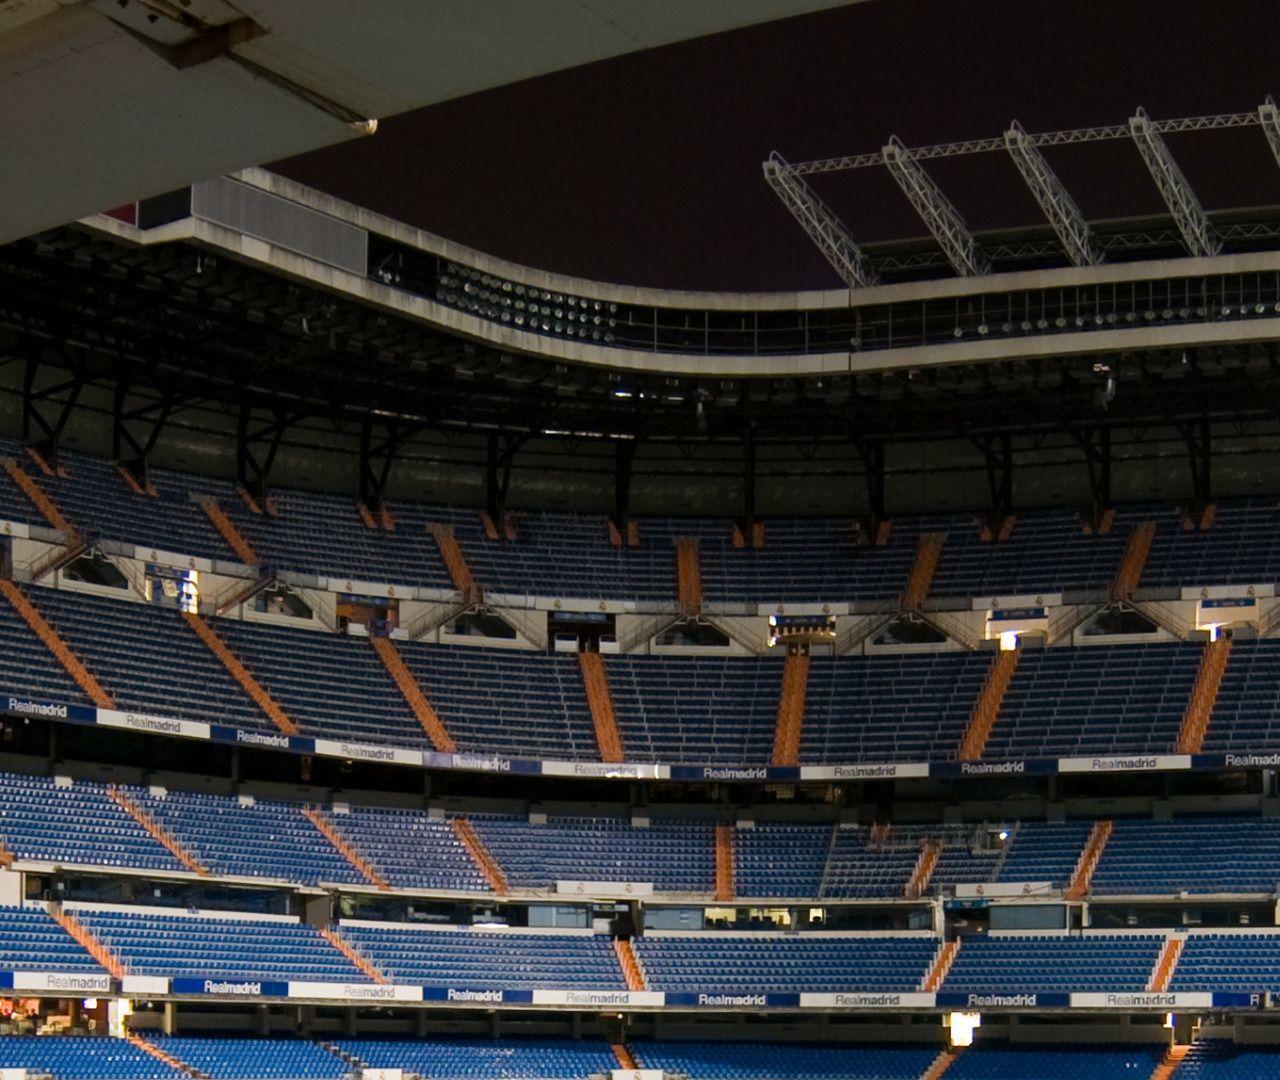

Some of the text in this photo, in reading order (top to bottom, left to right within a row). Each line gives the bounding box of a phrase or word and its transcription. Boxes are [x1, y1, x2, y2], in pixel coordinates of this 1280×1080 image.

[9, 698, 67, 719] Realmadrid
[126, 714, 181, 734] Realmadrid
[237, 729, 289, 748] Realmadrid
[961, 761, 1024, 774] Realmadrid
[1092, 757, 1157, 770] Realmadrid
[704, 767, 767, 779] Realmadrid
[834, 766, 896, 777] Realmadrid
[47, 975, 108, 989] Realmadrid
[566, 993, 629, 1004] Realmadrid
[699, 994, 766, 1006] Realmadrid
[835, 994, 900, 1006] Realmadrid
[967, 994, 1036, 1006] Realmadrid
[1107, 994, 1176, 1006] Realmadrid
